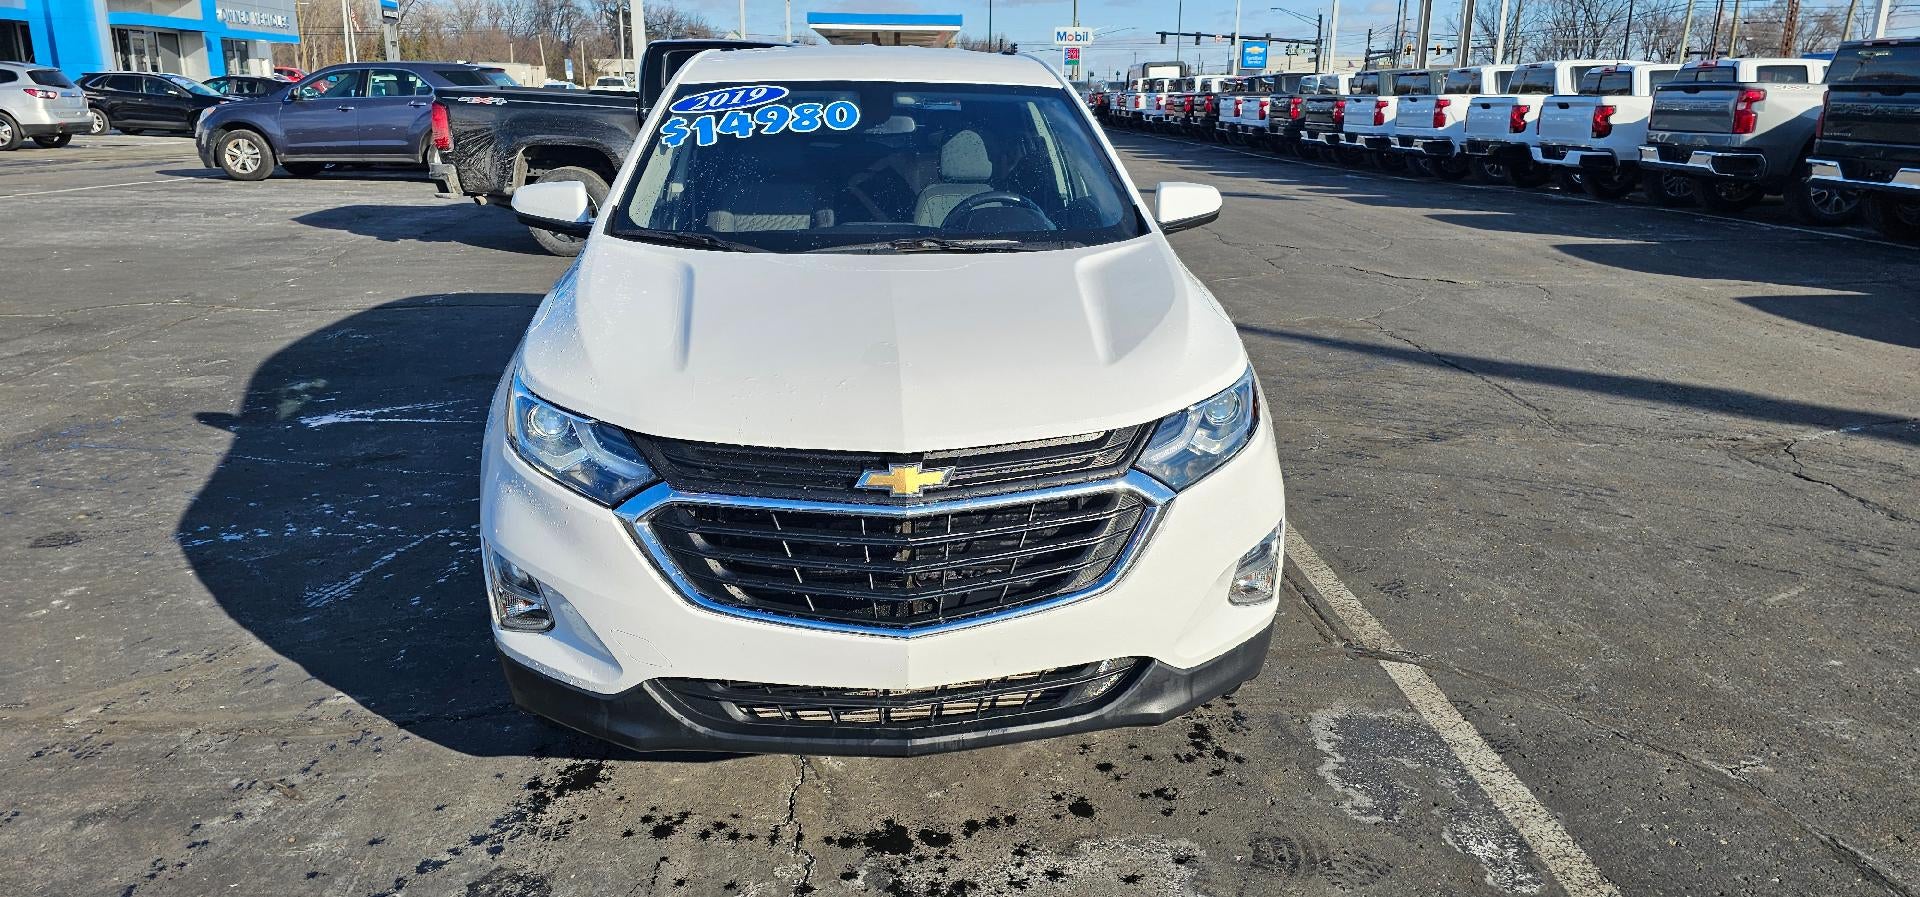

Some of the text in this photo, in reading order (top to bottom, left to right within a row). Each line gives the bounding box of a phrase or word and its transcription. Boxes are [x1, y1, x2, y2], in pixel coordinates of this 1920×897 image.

[1056, 31, 1089, 42] Mobil
[688, 87, 768, 111] 2019
[660, 101, 860, 147] $14980
